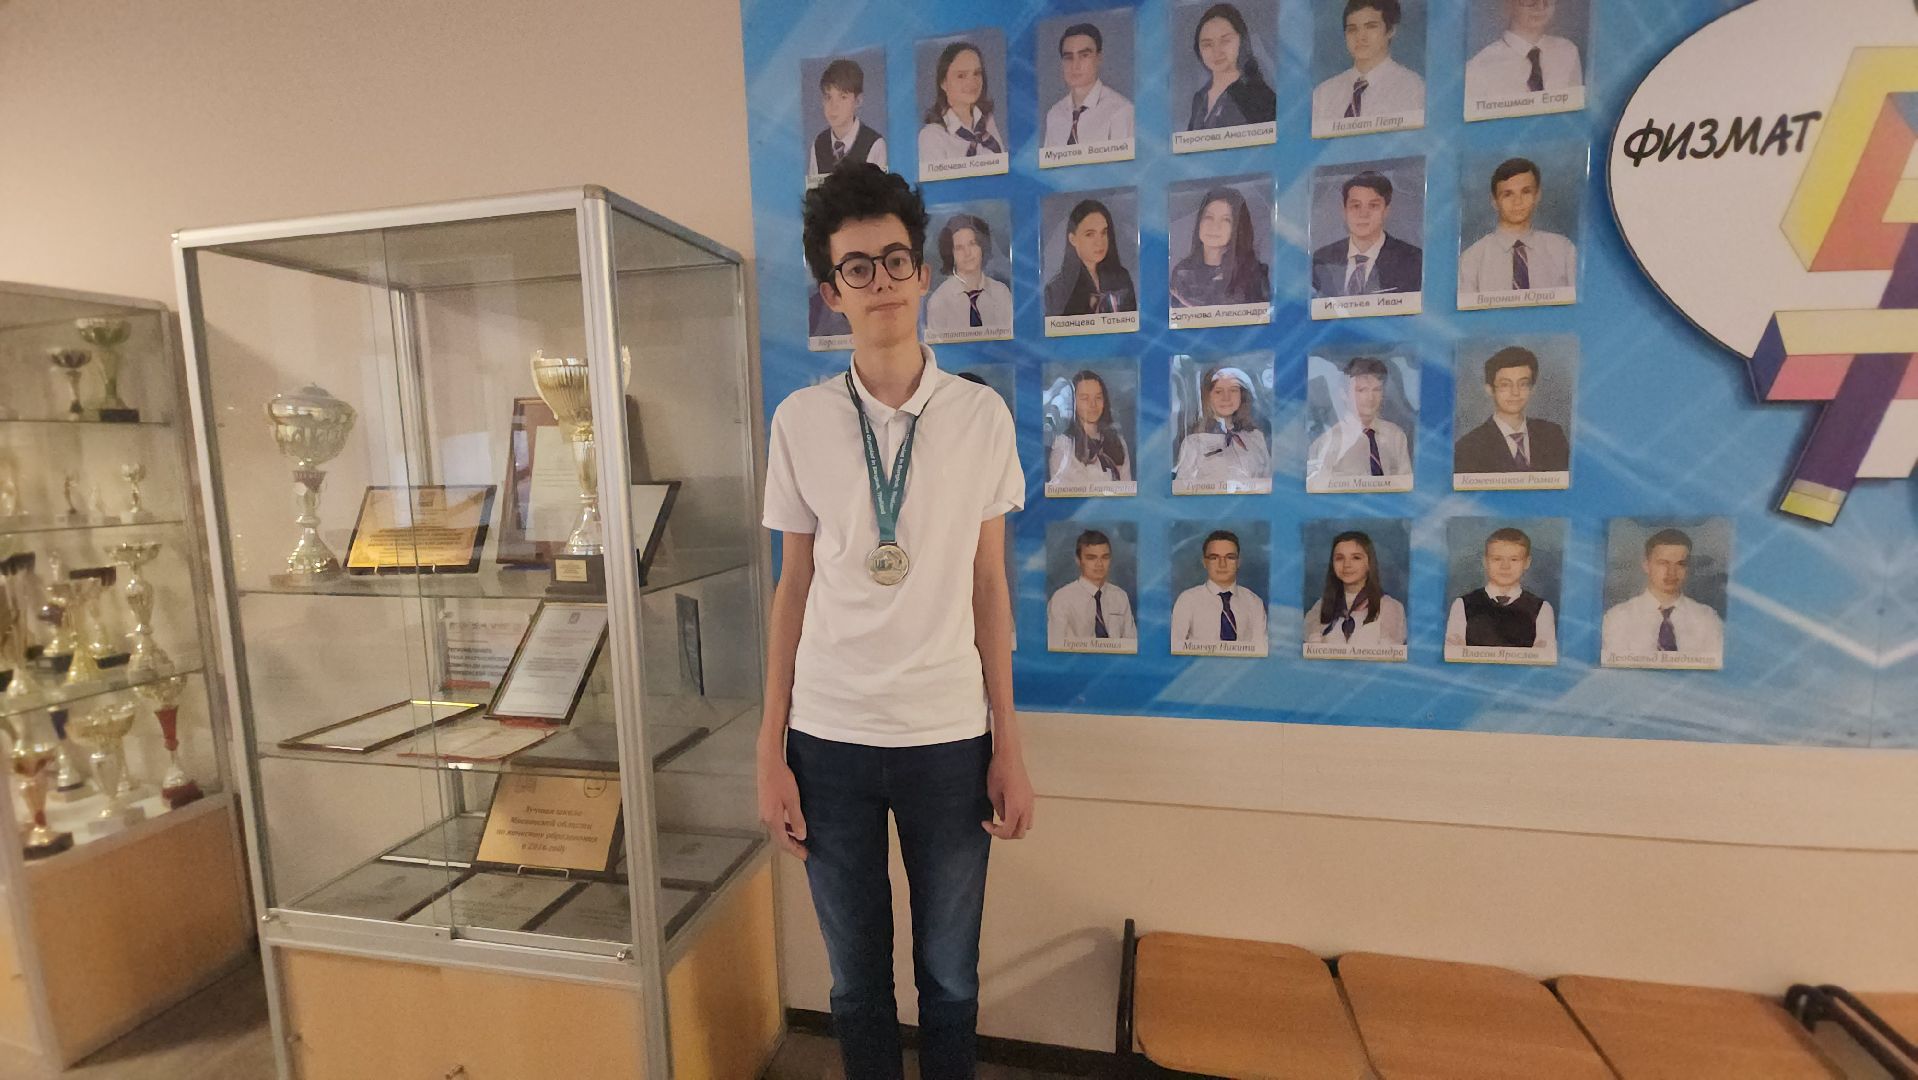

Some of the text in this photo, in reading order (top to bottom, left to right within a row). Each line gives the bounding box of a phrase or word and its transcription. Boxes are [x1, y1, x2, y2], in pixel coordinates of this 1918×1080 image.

[1542, 93, 1569, 104] Егор
[1174, 127, 1274, 145] Пирогова Анастасия
[1623, 110, 1822, 168] ФИЗМАТ
[1045, 149, 1083, 160] Муратов
[1378, 297, 1403, 306] Иван
[1050, 316, 1136, 329] Казанцева Татьяна
[1350, 646, 1404, 658] Александра
